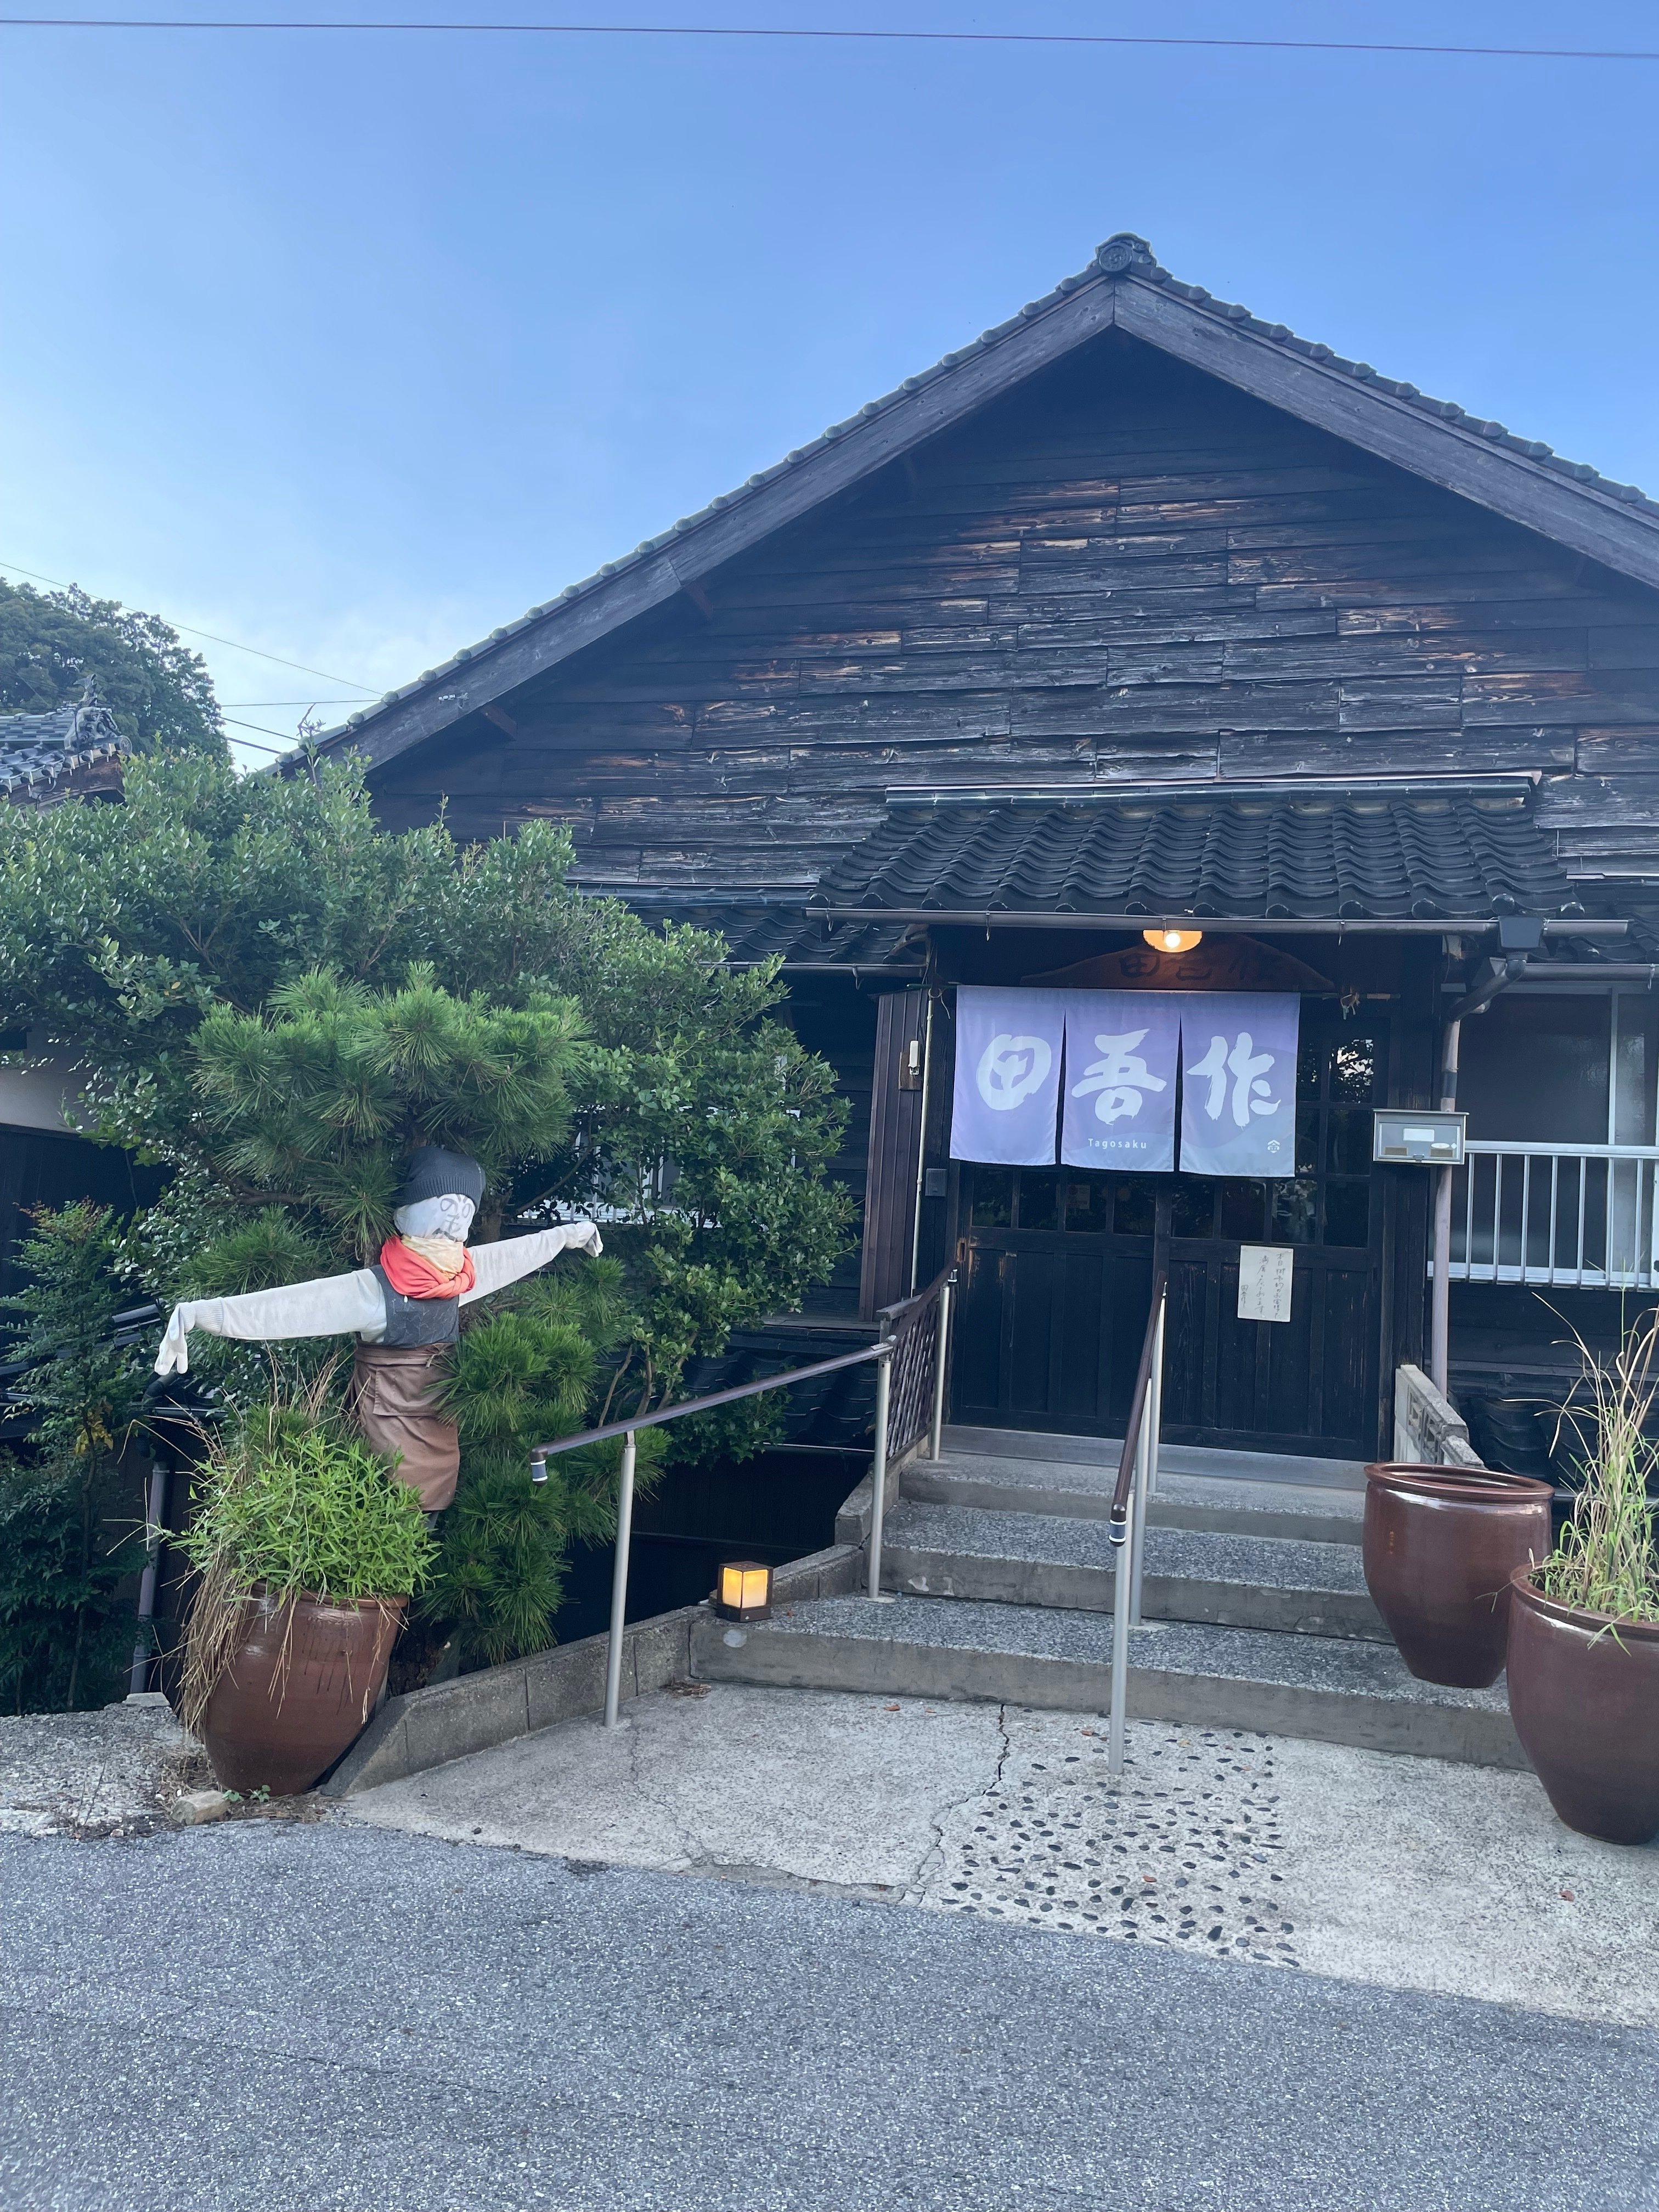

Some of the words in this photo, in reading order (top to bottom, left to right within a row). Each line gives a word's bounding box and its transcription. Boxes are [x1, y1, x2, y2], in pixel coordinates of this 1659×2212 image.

[976, 1028, 1282, 1127] 田吾作
[1087, 1137, 1148, 1150] Tagosaku
